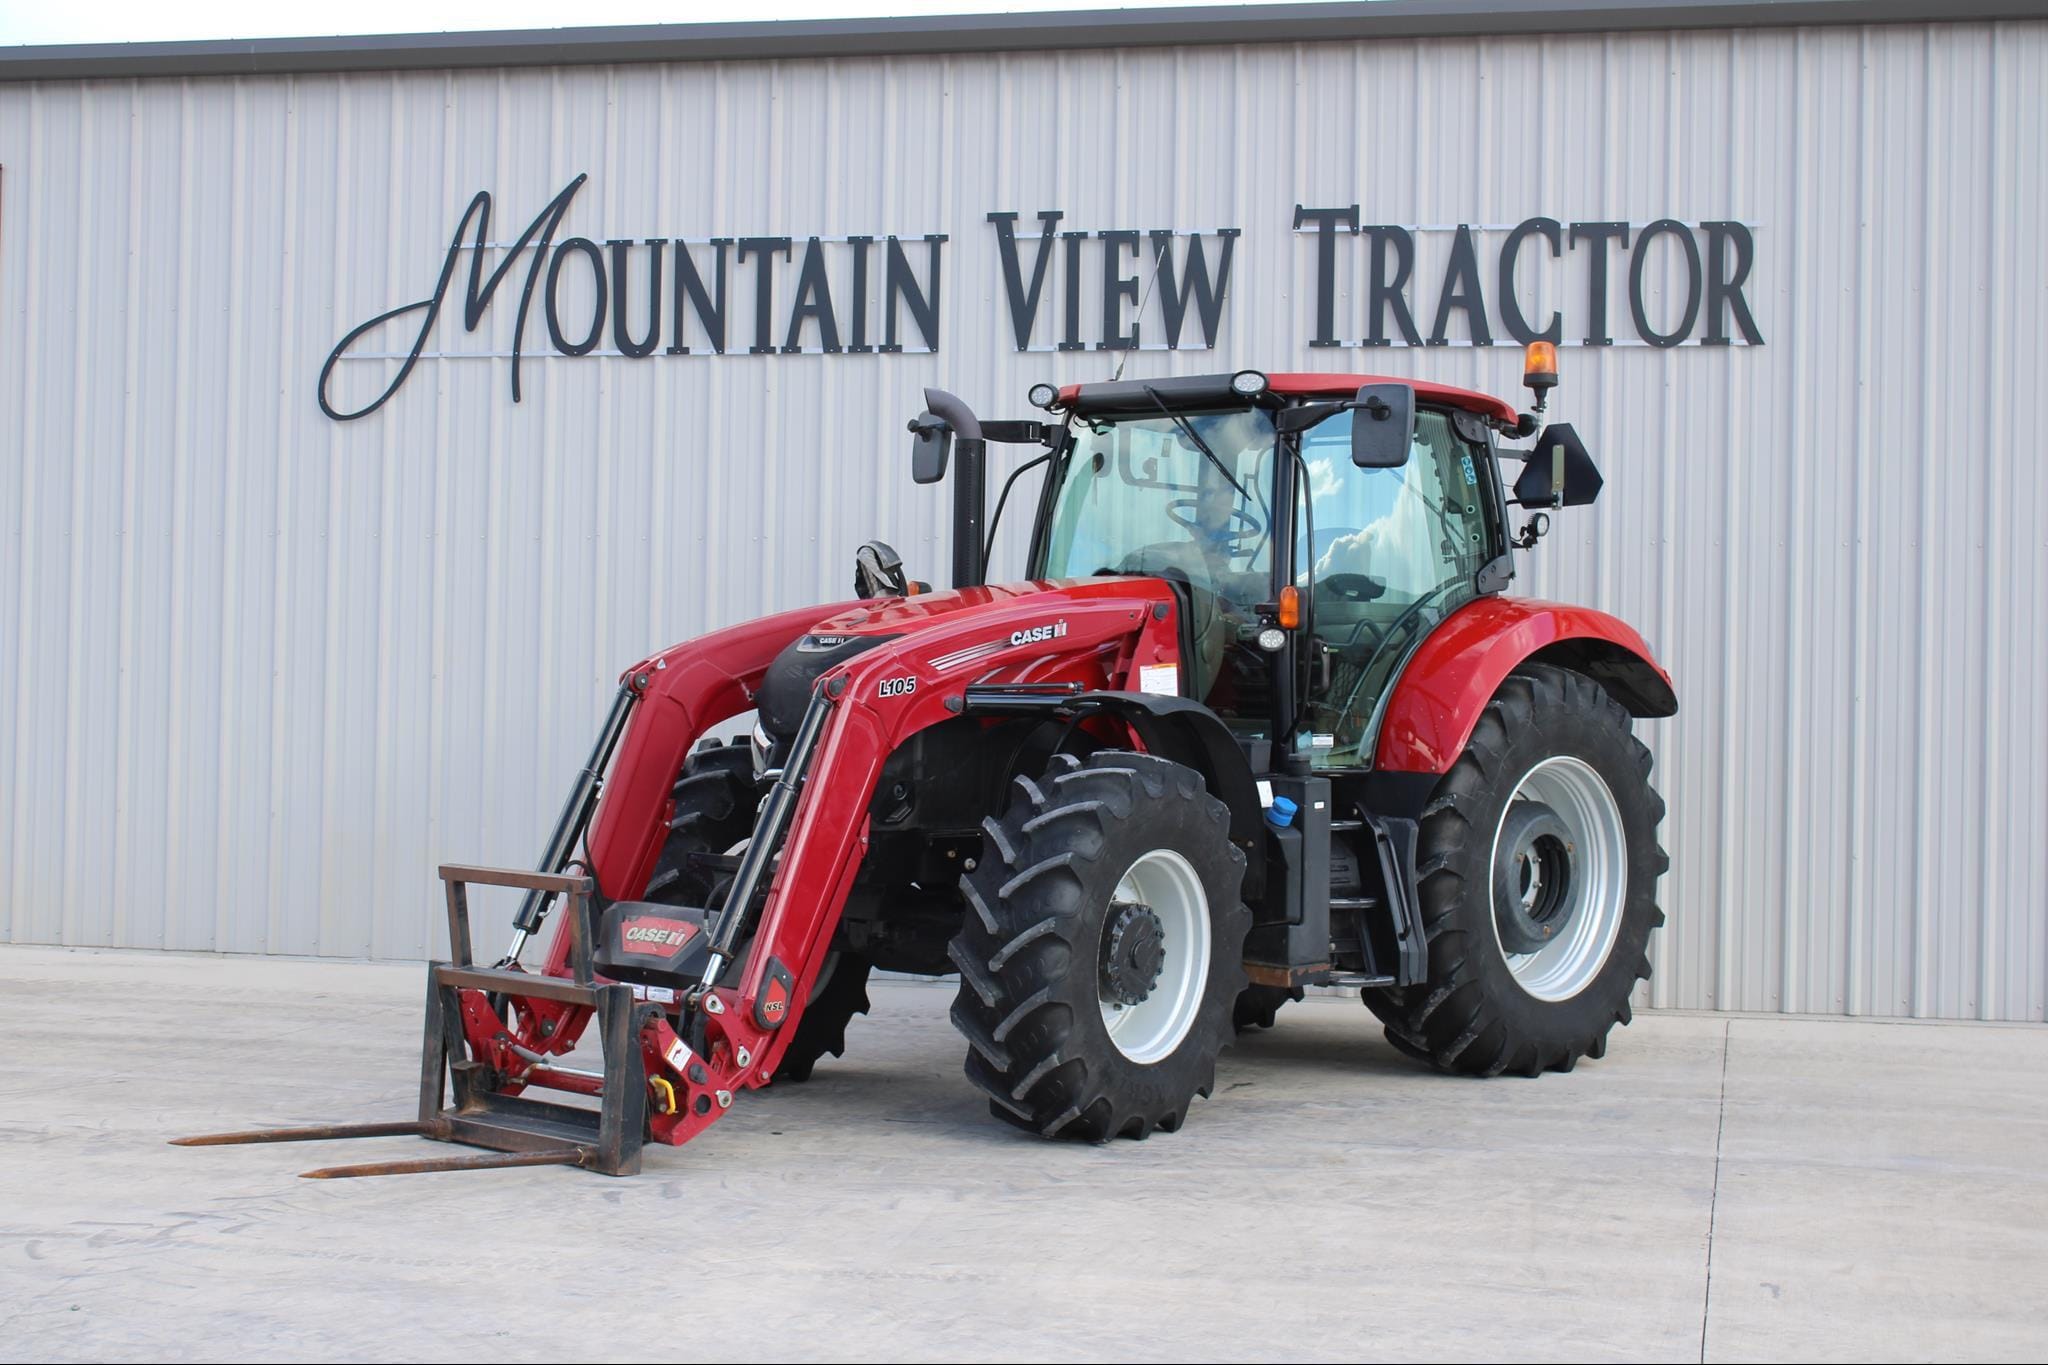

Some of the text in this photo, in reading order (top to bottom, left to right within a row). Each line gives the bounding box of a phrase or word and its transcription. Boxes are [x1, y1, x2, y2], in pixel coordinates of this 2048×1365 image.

[318, 173, 1766, 421] MOUNTAIN VIEW TRACTOR
[1010, 625, 1053, 646] CASE
[878, 675, 917, 698] L105
[625, 926, 668, 943] CASE
[765, 1000, 784, 1012] NSL
